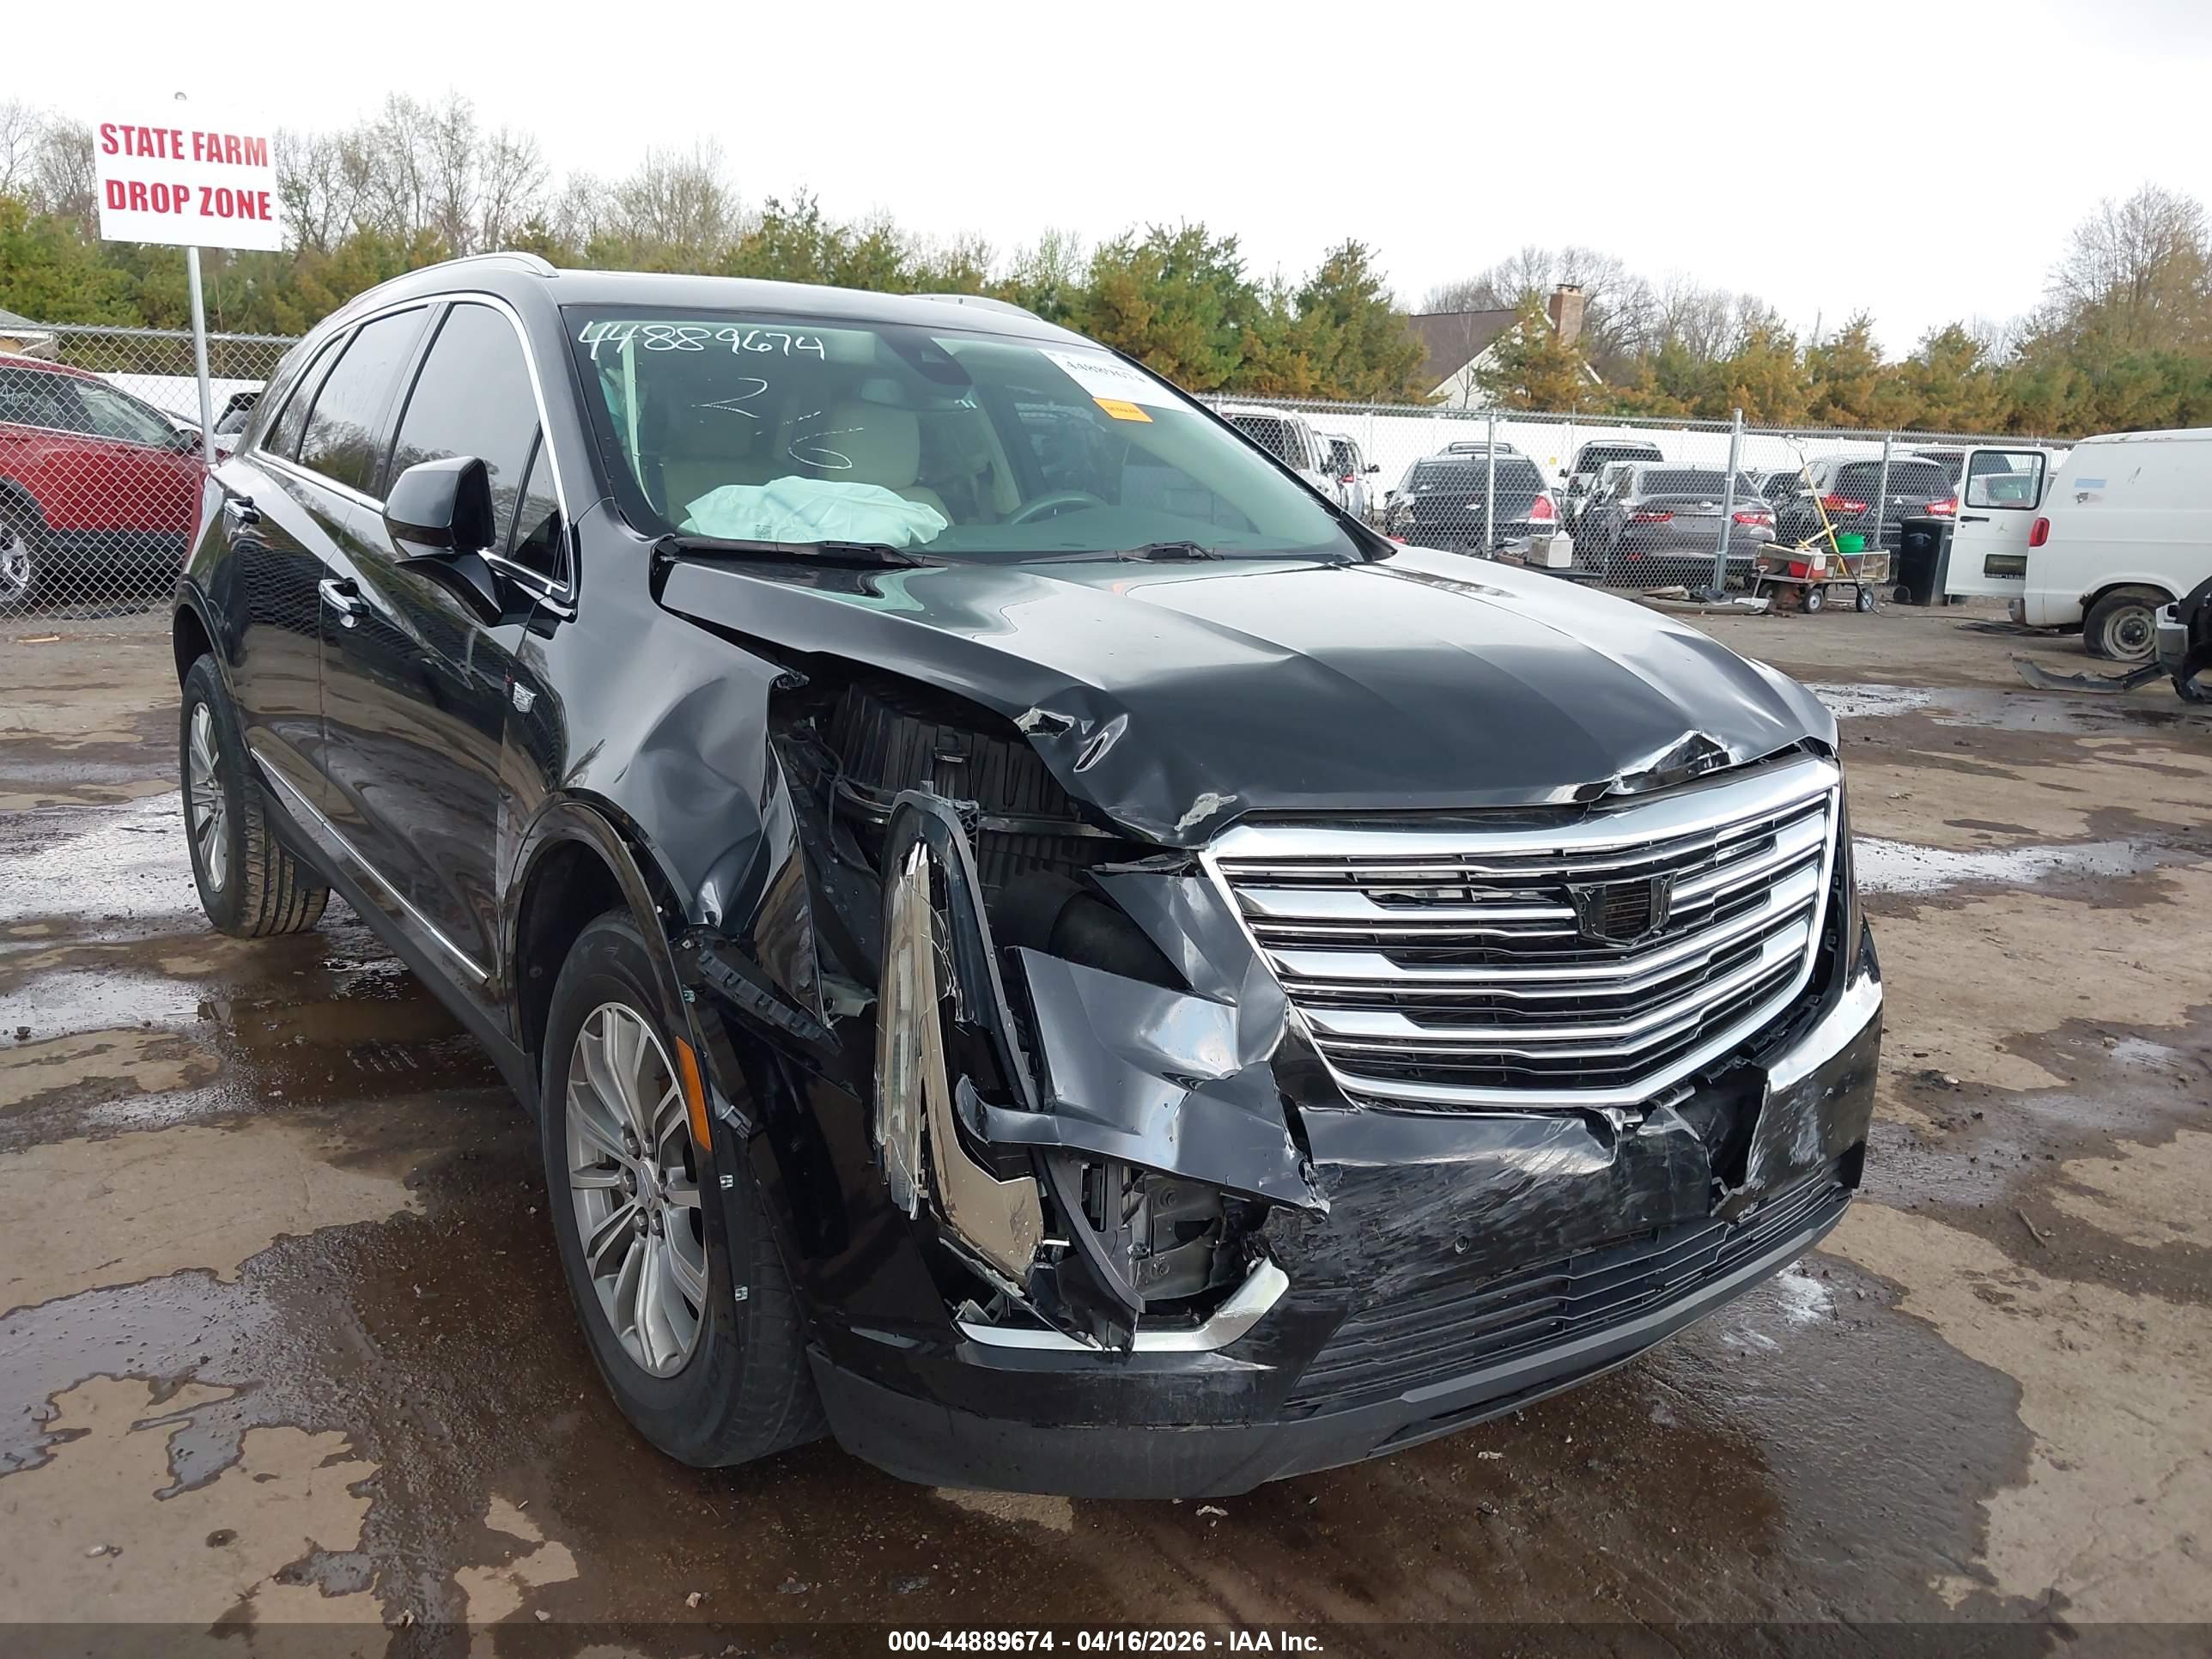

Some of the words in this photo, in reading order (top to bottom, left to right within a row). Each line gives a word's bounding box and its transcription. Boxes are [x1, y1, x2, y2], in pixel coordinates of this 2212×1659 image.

[100, 122, 185, 160] STATE
[191, 131, 269, 167] FARM
[105, 179, 191, 215] DROP
[198, 185, 273, 221] ZONE
[577, 320, 825, 361] 44889674
